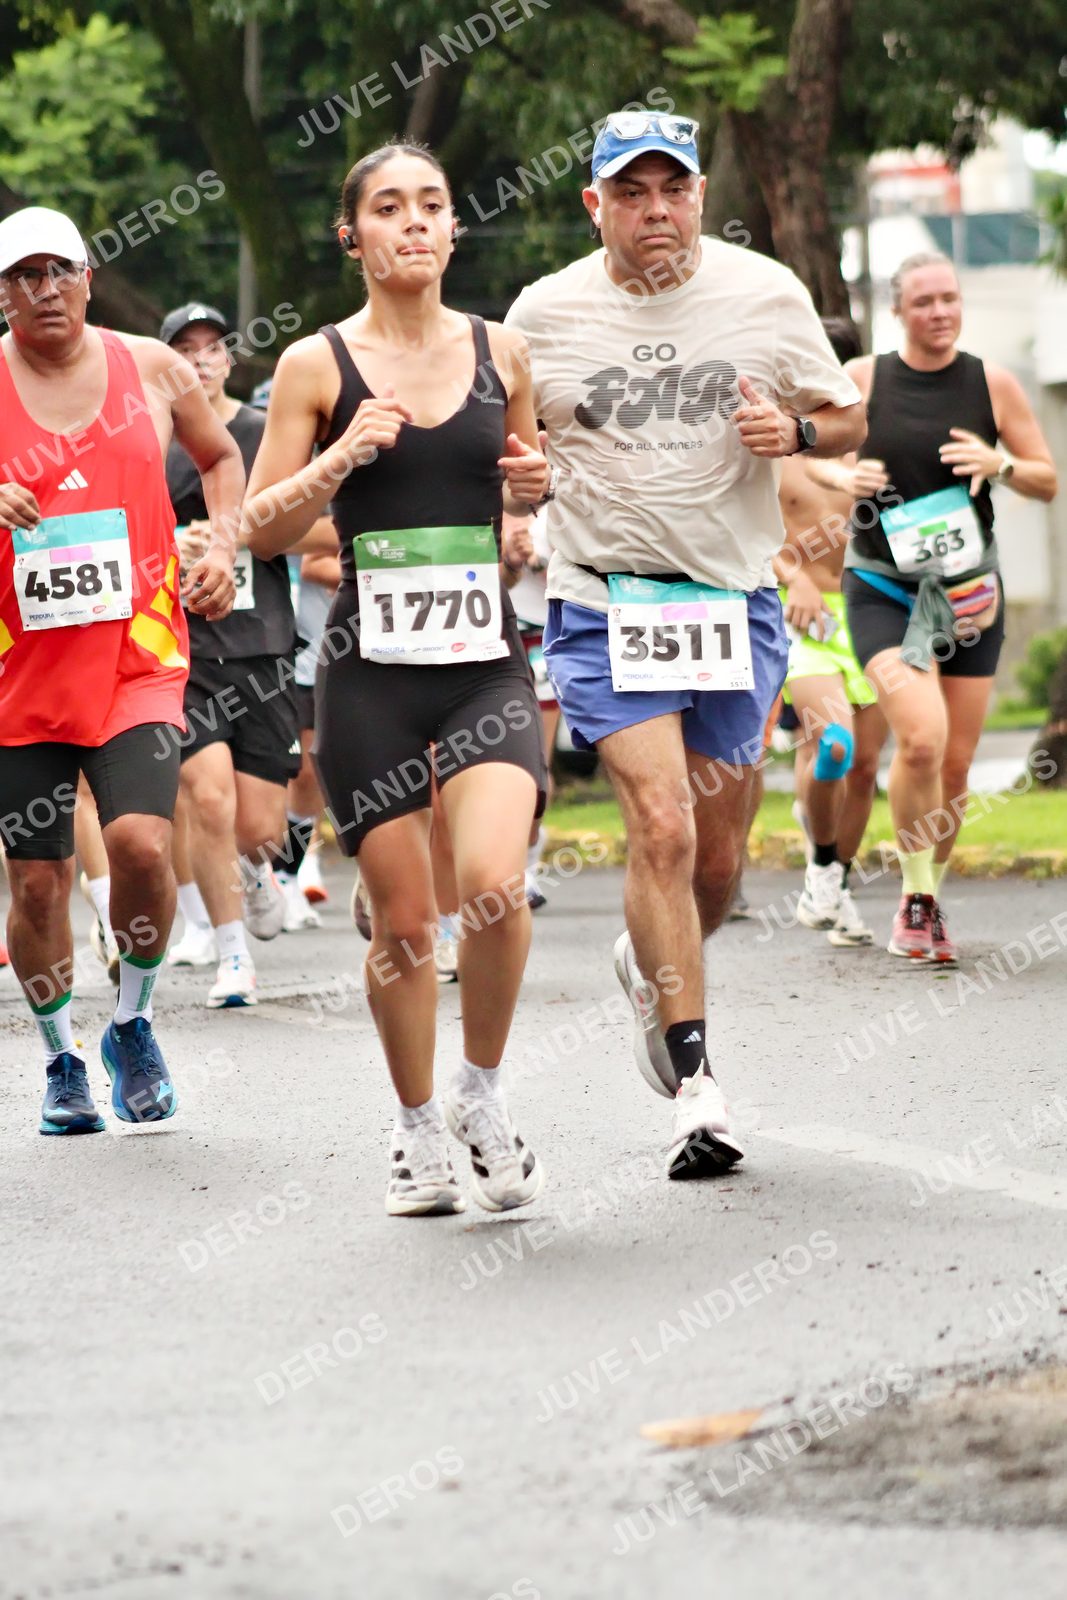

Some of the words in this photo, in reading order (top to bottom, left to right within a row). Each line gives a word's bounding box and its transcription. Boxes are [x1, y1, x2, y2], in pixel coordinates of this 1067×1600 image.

[632, 343, 676, 362] GO
[614, 442, 633, 451] FOR
[636, 442, 656, 450] ALL
[911, 528, 965, 563] 363
[24, 560, 123, 603] 4581
[373, 589, 492, 633] 1770
[620, 623, 732, 662] 3511
